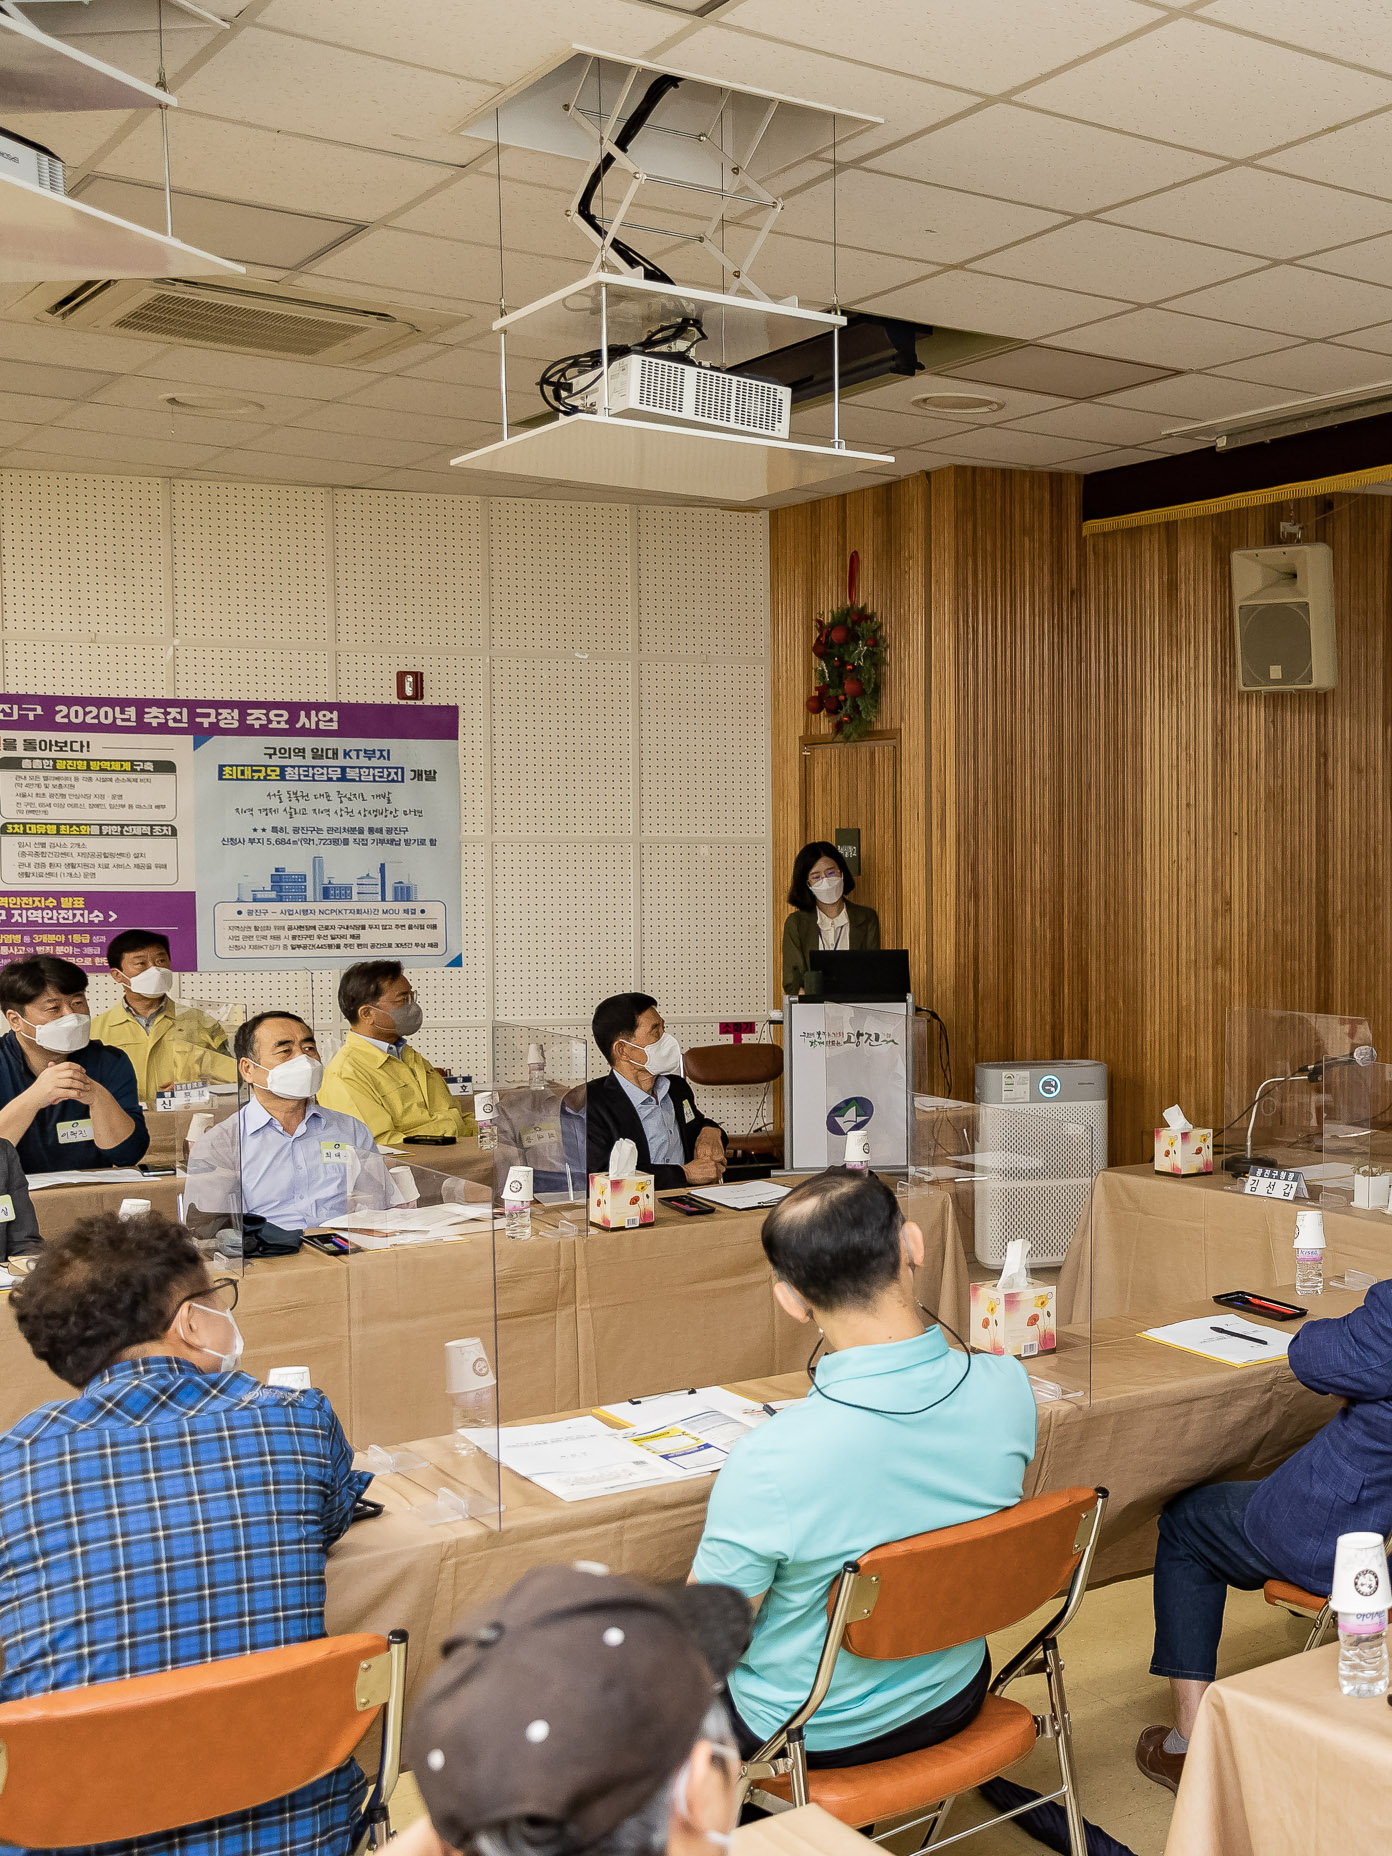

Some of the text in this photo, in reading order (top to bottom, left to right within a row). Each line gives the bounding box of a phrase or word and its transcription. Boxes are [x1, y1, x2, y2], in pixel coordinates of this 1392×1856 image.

[55, 705, 137, 726] 2020년
[144, 706, 188, 728] 추진
[195, 708, 239, 728] 구정
[246, 709, 290, 729] 주요
[295, 710, 339, 730] 사업
[23, 738, 90, 753] 돌아보다!
[264, 747, 391, 761] 구의역 일대 KT부지
[56, 759, 87, 771] 광진형
[222, 766, 438, 782] 최대규모 첨단업무 복합단지 개발
[60, 897, 85, 908] 발표
[11, 909, 104, 924] 지역안전지수
[722, 1023, 755, 1034] 소화기
